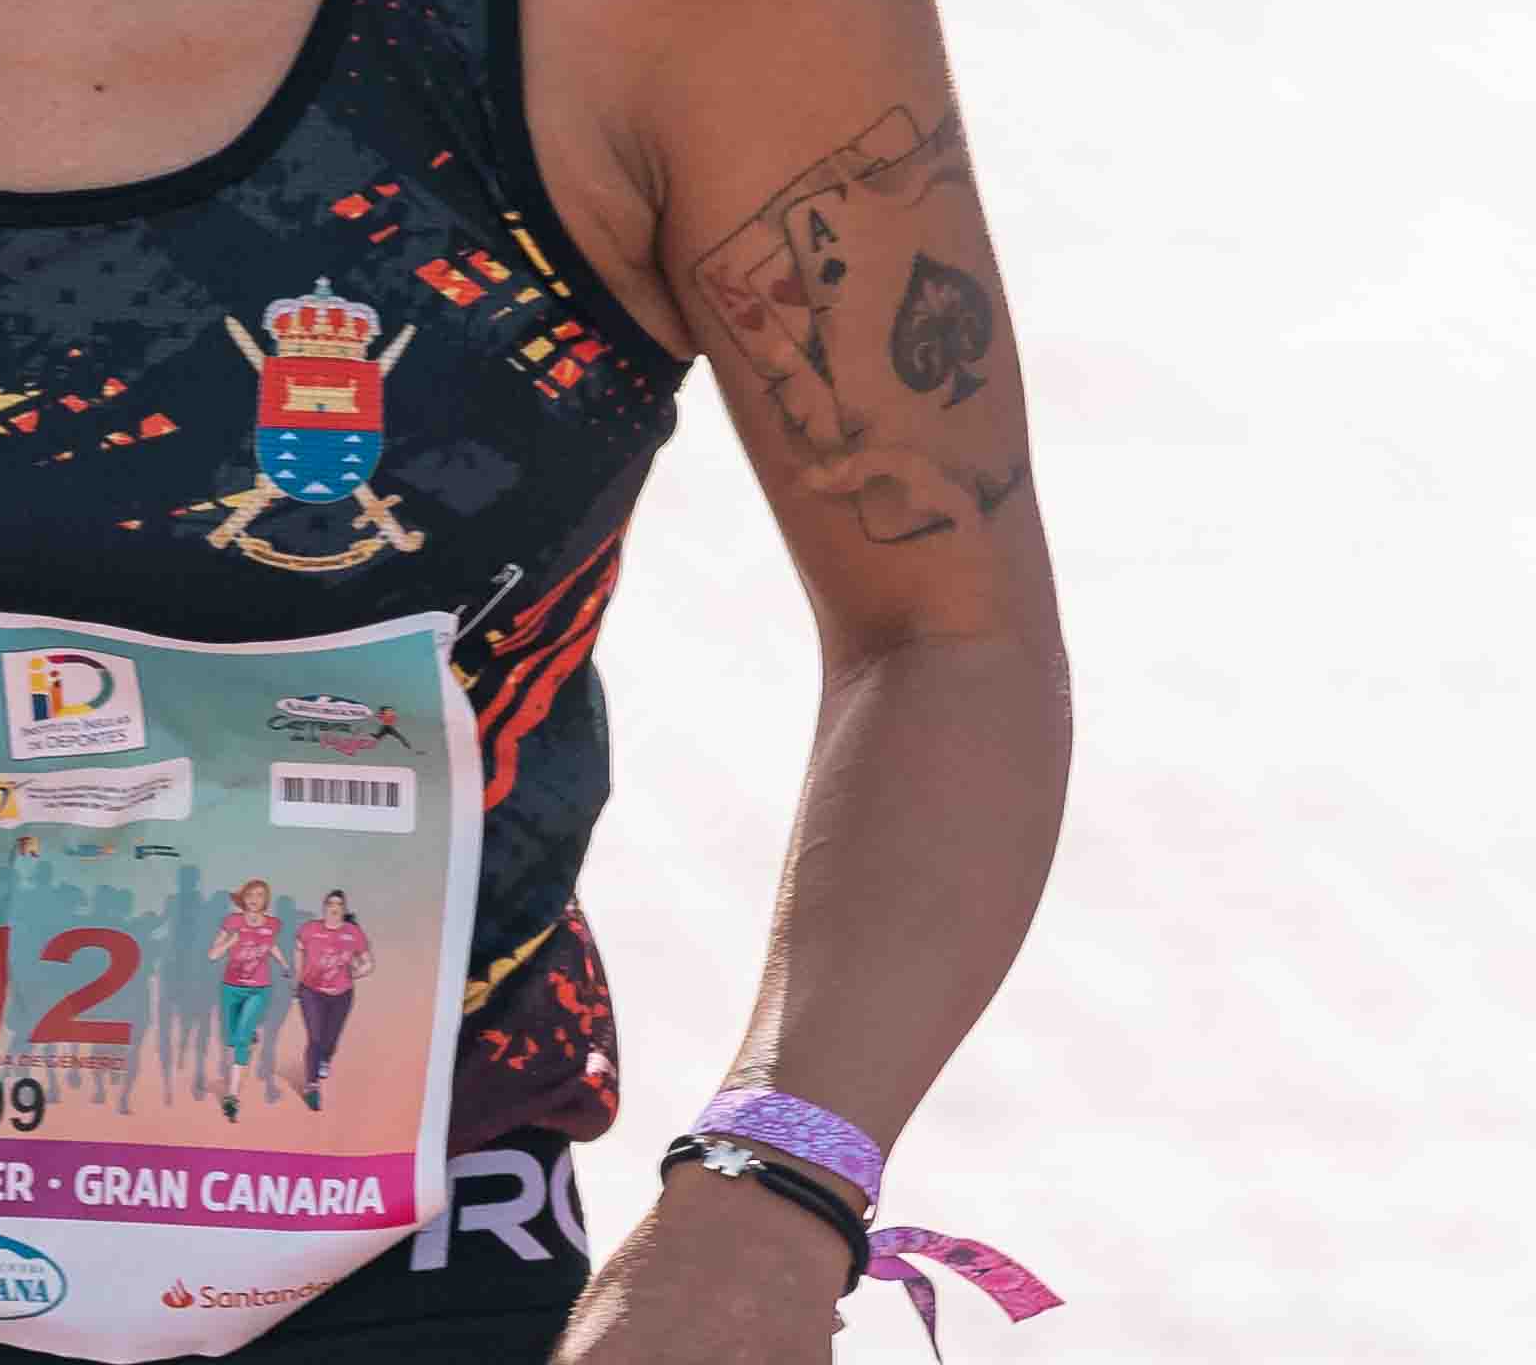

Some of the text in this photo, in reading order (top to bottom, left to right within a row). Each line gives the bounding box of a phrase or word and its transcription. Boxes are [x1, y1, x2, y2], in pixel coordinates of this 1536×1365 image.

[46, 729, 130, 749] DEPORTES
[73, 1164, 189, 1210] GRAN
[199, 1170, 386, 1216] CANARIA
